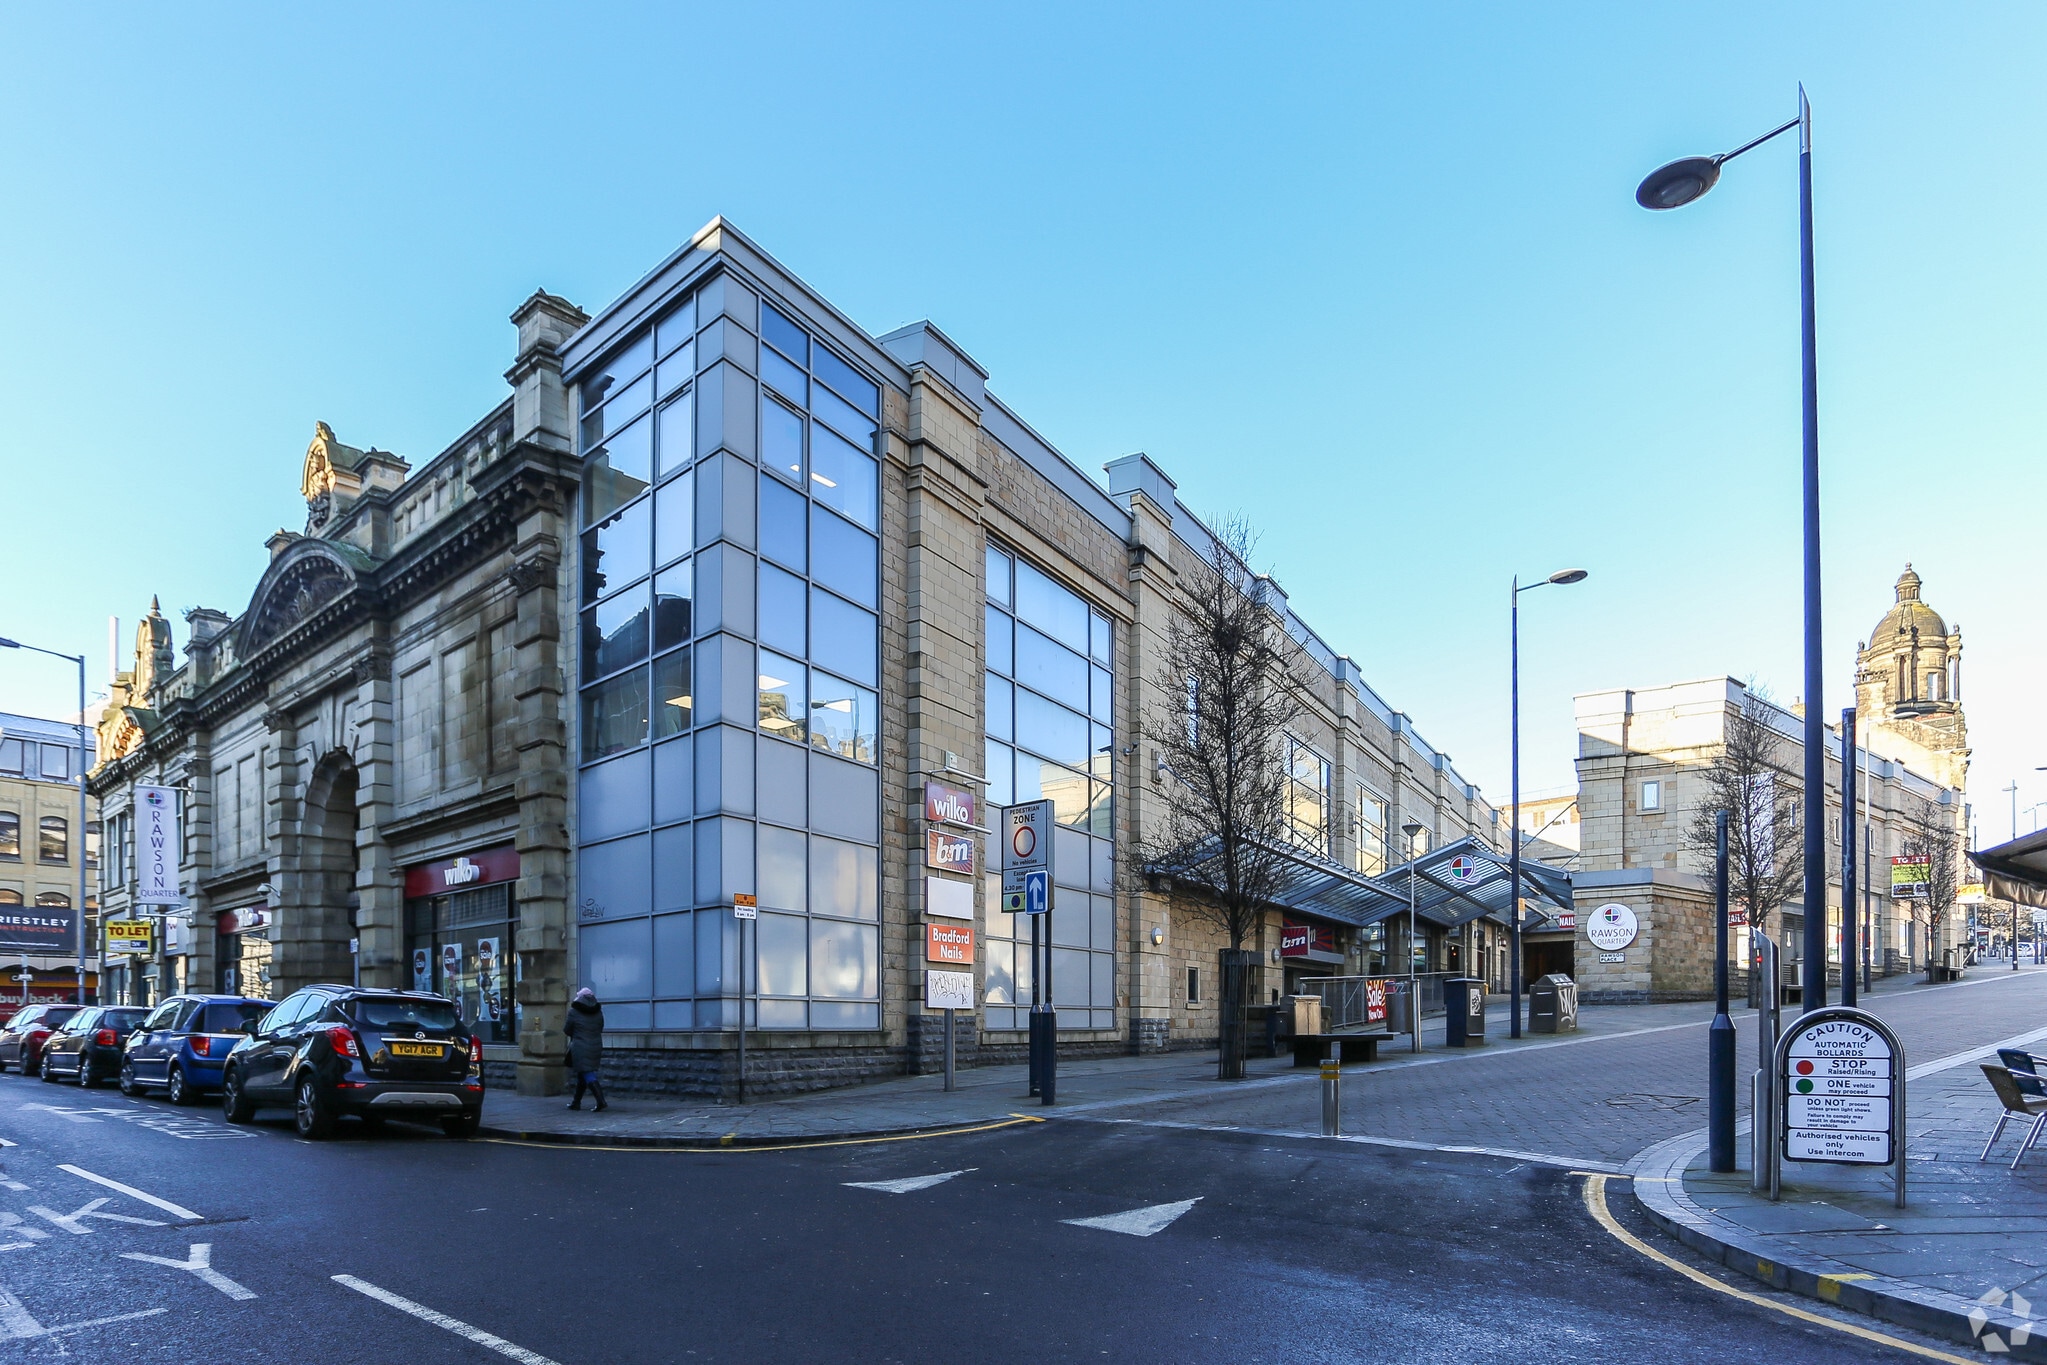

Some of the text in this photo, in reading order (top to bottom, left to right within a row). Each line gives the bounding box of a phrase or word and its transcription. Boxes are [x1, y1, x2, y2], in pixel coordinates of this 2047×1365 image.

[933, 794, 969, 823] wilko
[1009, 805, 1040, 815] PEDESTRIAN
[1013, 813, 1036, 824] ZONE
[150, 811, 165, 888] RAWSON
[444, 857, 480, 885] wilko
[140, 889, 179, 898] QUARTER
[108, 926, 149, 936] TO LET
[933, 927, 970, 945] Bradford
[1591, 928, 1633, 938] RAWSON
[1597, 938, 1627, 946] QUARTER
[940, 944, 963, 960] Nails
[0, 993, 64, 1007] buy back
[1367, 984, 1382, 1007] Sale
[1805, 1023, 1874, 1043] CAUTION
[420, 1045, 438, 1055] AGR
[1814, 1041, 1867, 1049] AUTOMATIC
[1816, 1049, 1864, 1057] BOLLARDS
[1831, 1059, 1868, 1069] STOP
[1827, 1080, 1851, 1089] ONE
[1807, 1098, 1822, 1106] DO
[1824, 1098, 1846, 1107] NOT
[1795, 1131, 1881, 1142] Authorised vehicles
[1825, 1141, 1844, 1149] only
[1807, 1148, 1824, 1156] Use
